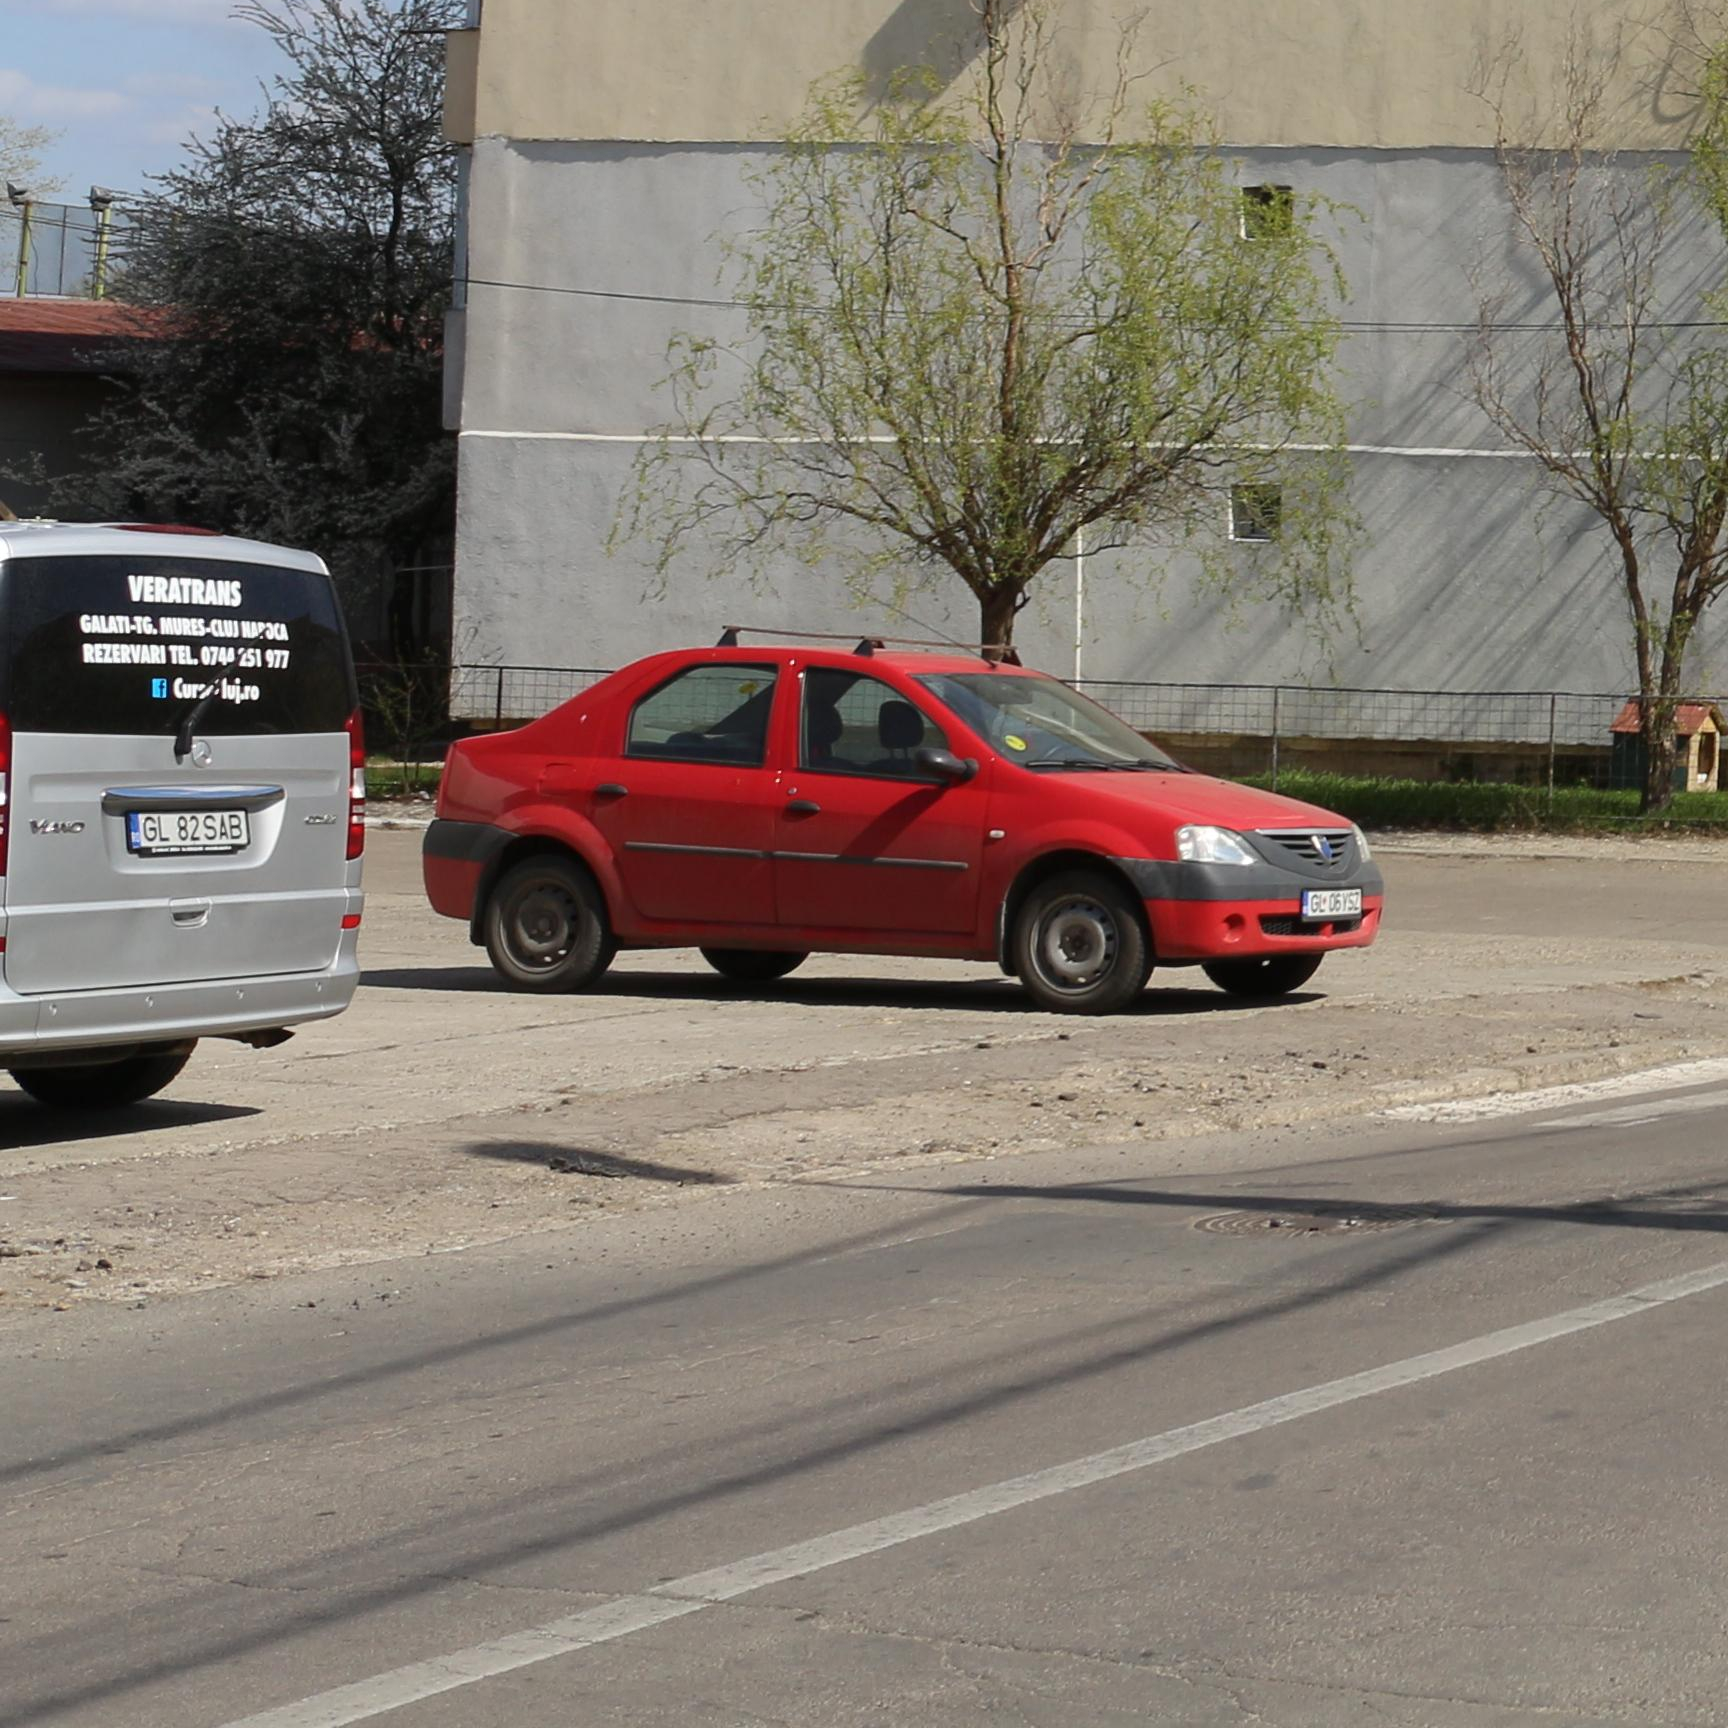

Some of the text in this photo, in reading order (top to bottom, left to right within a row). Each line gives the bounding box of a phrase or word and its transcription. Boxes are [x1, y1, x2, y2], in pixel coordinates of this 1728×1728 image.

[127, 575, 242, 607] VERATRANS
[80, 614, 158, 635] GALATI-TG.
[159, 617, 240, 637] MURES-CLUJ
[82, 643, 166, 664] REZERVARI
[168, 645, 198, 665] TEL.
[238, 648, 262, 668] 251
[265, 649, 290, 669] 977
[173, 677, 260, 704] Cursluj.ro
[143, 816, 169, 842] GL
[1311, 894, 1326, 913] GL
